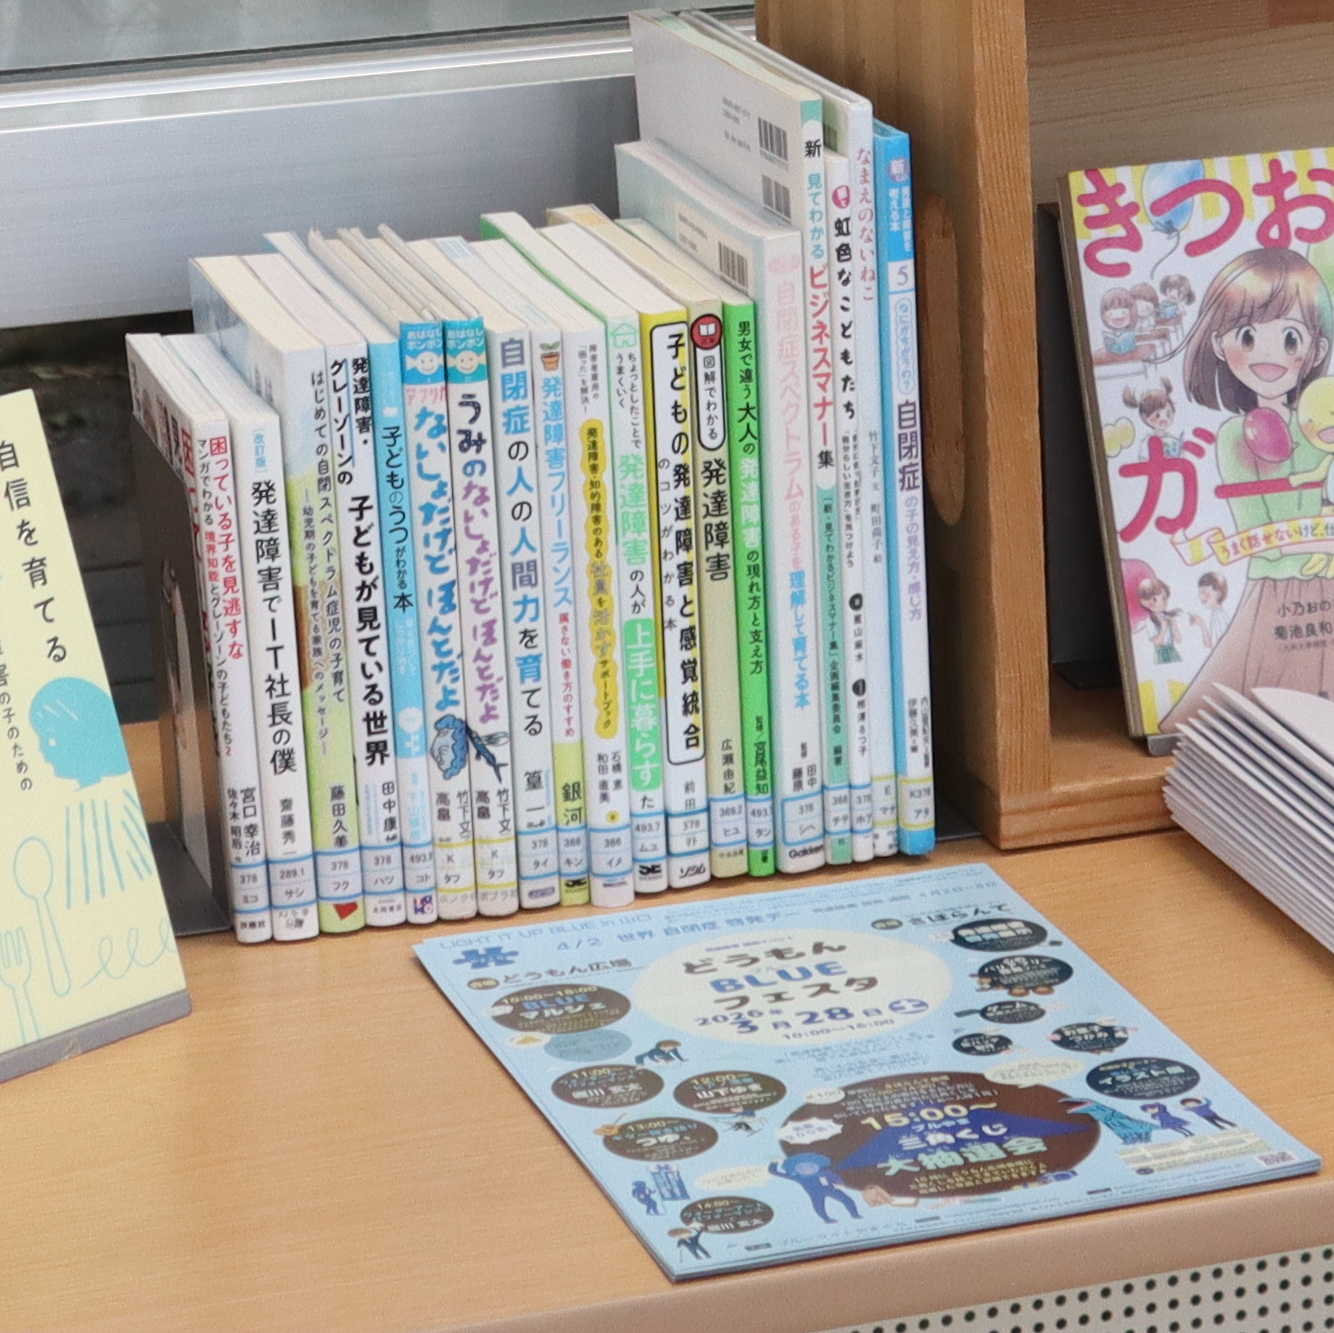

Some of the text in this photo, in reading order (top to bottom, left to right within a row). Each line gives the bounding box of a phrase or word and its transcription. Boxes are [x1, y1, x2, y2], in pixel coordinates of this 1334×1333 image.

[804, 139, 835, 470] 新 見てわかる ビジネスマナー集
[834, 217, 856, 420] 虹色なこどもたち
[856, 148, 875, 301] なまえのないねこ
[896, 264, 909, 287] 5
[197, 438, 216, 527] マンガでわかる
[329, 357, 354, 487] グレーゾーンの
[381, 426, 414, 614] 子どものうつがわかる本
[541, 376, 573, 609] 発達障害フリーランス
[700, 354, 732, 582] 図解でわかる 発達障害
[736, 321, 765, 676] 男女で違う大人の発達障害の現れ方と支え方
[209, 436, 245, 661] 困っている子を見逃すな
[347, 494, 392, 768] 子どもが見ている世界
[500, 338, 544, 737] 自閉症の人の人間力を育てる
[667, 332, 701, 751] 子どもの発達障害と感覚統合
[561, 781, 584, 827] 銀河
[709, 960, 849, 994] BLUE
[713, 975, 879, 1012] フェスタ
